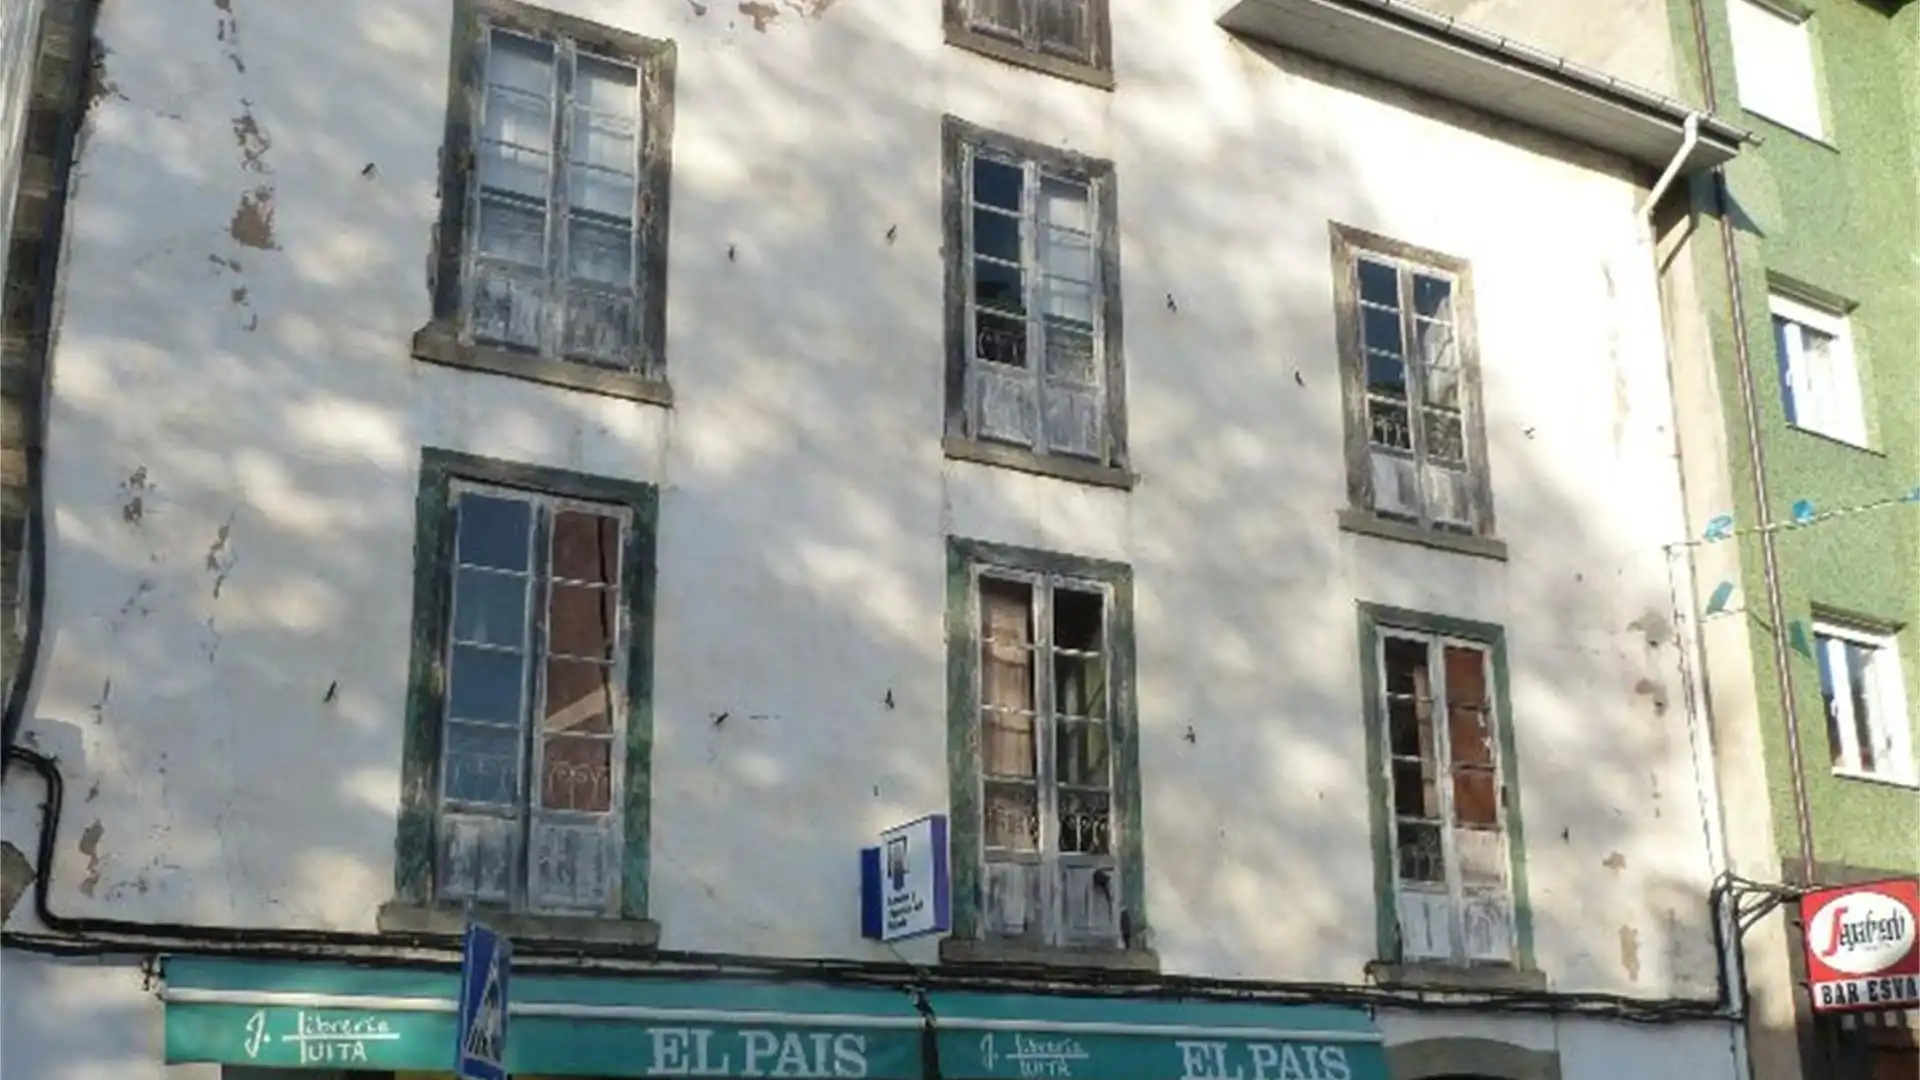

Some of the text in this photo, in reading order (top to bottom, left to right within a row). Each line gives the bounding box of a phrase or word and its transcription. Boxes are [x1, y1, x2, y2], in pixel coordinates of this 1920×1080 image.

[1821, 977, 1918, 1004] BAR ESVA
[647, 1028, 868, 1078] EL PAIS
[1175, 1041, 1351, 1080] EL PAIS
